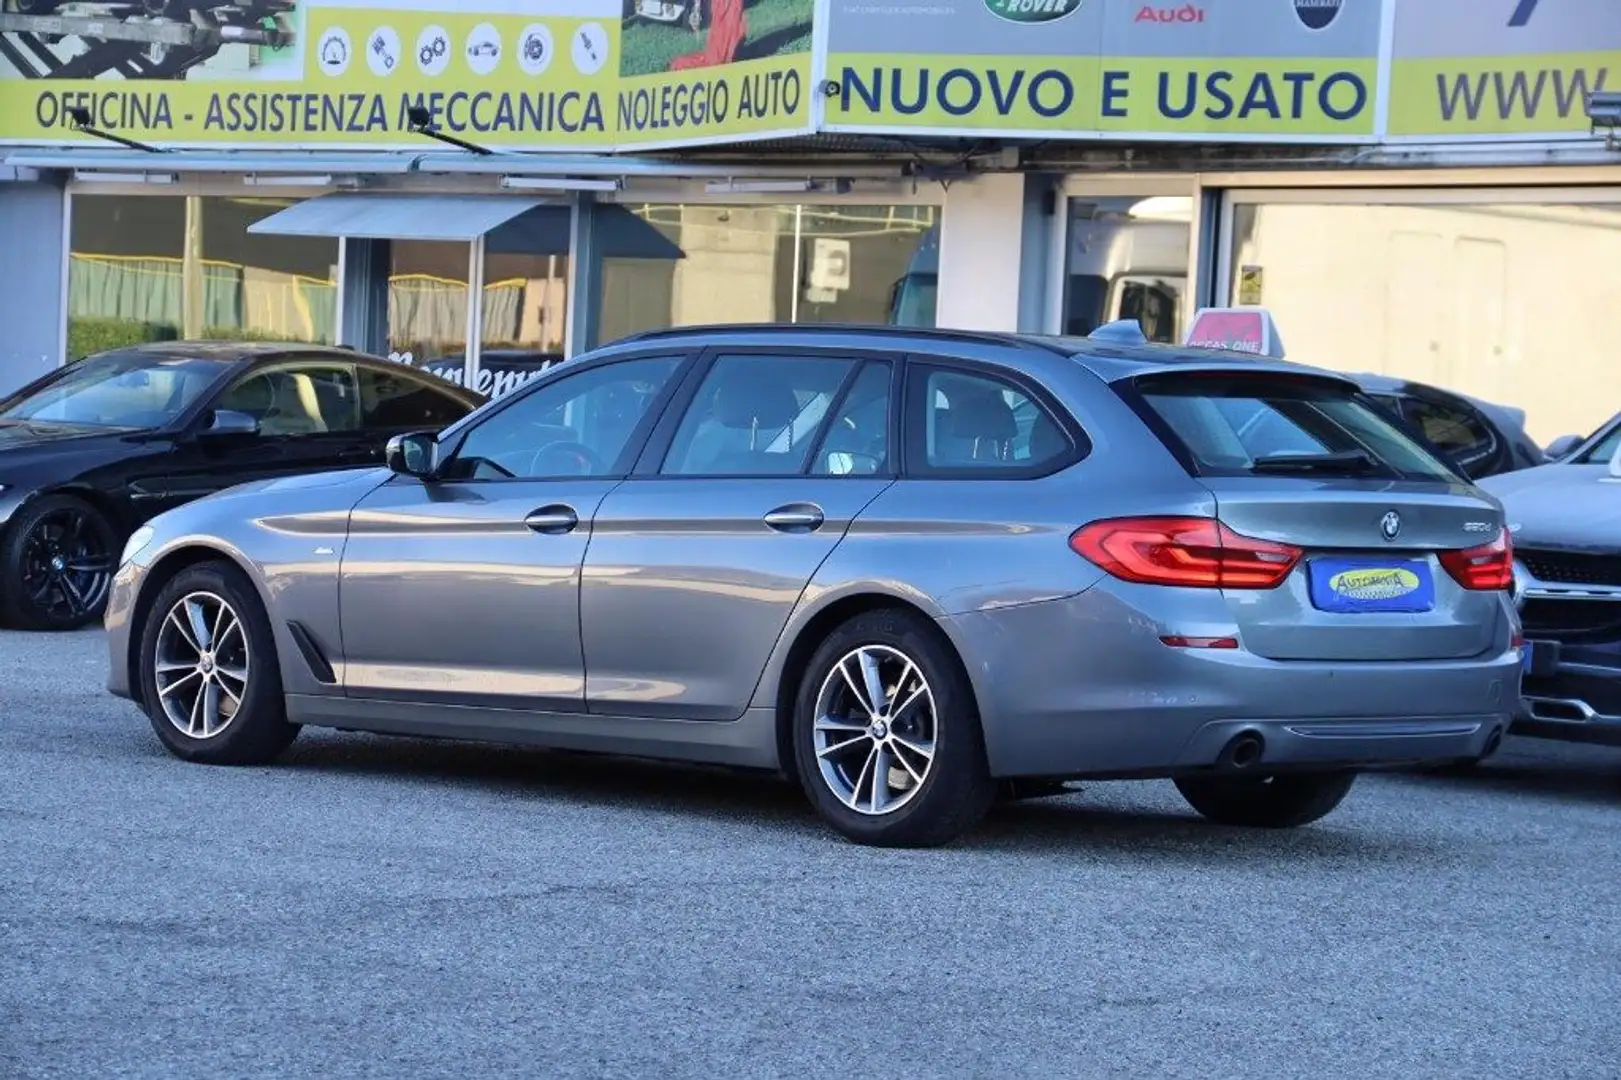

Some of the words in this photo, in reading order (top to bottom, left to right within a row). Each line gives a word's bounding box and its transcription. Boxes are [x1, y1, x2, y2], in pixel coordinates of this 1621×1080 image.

[1134, 4, 1204, 23] Audi
[204, 92, 388, 132] ASSISTENZA
[397, 91, 604, 132] MECCANICA
[617, 79, 730, 131] NOLEGGIO
[737, 68, 800, 120] AUTO
[841, 67, 1074, 117] NUOVO
[1102, 71, 1129, 117] E
[1158, 71, 1367, 120] USATO
